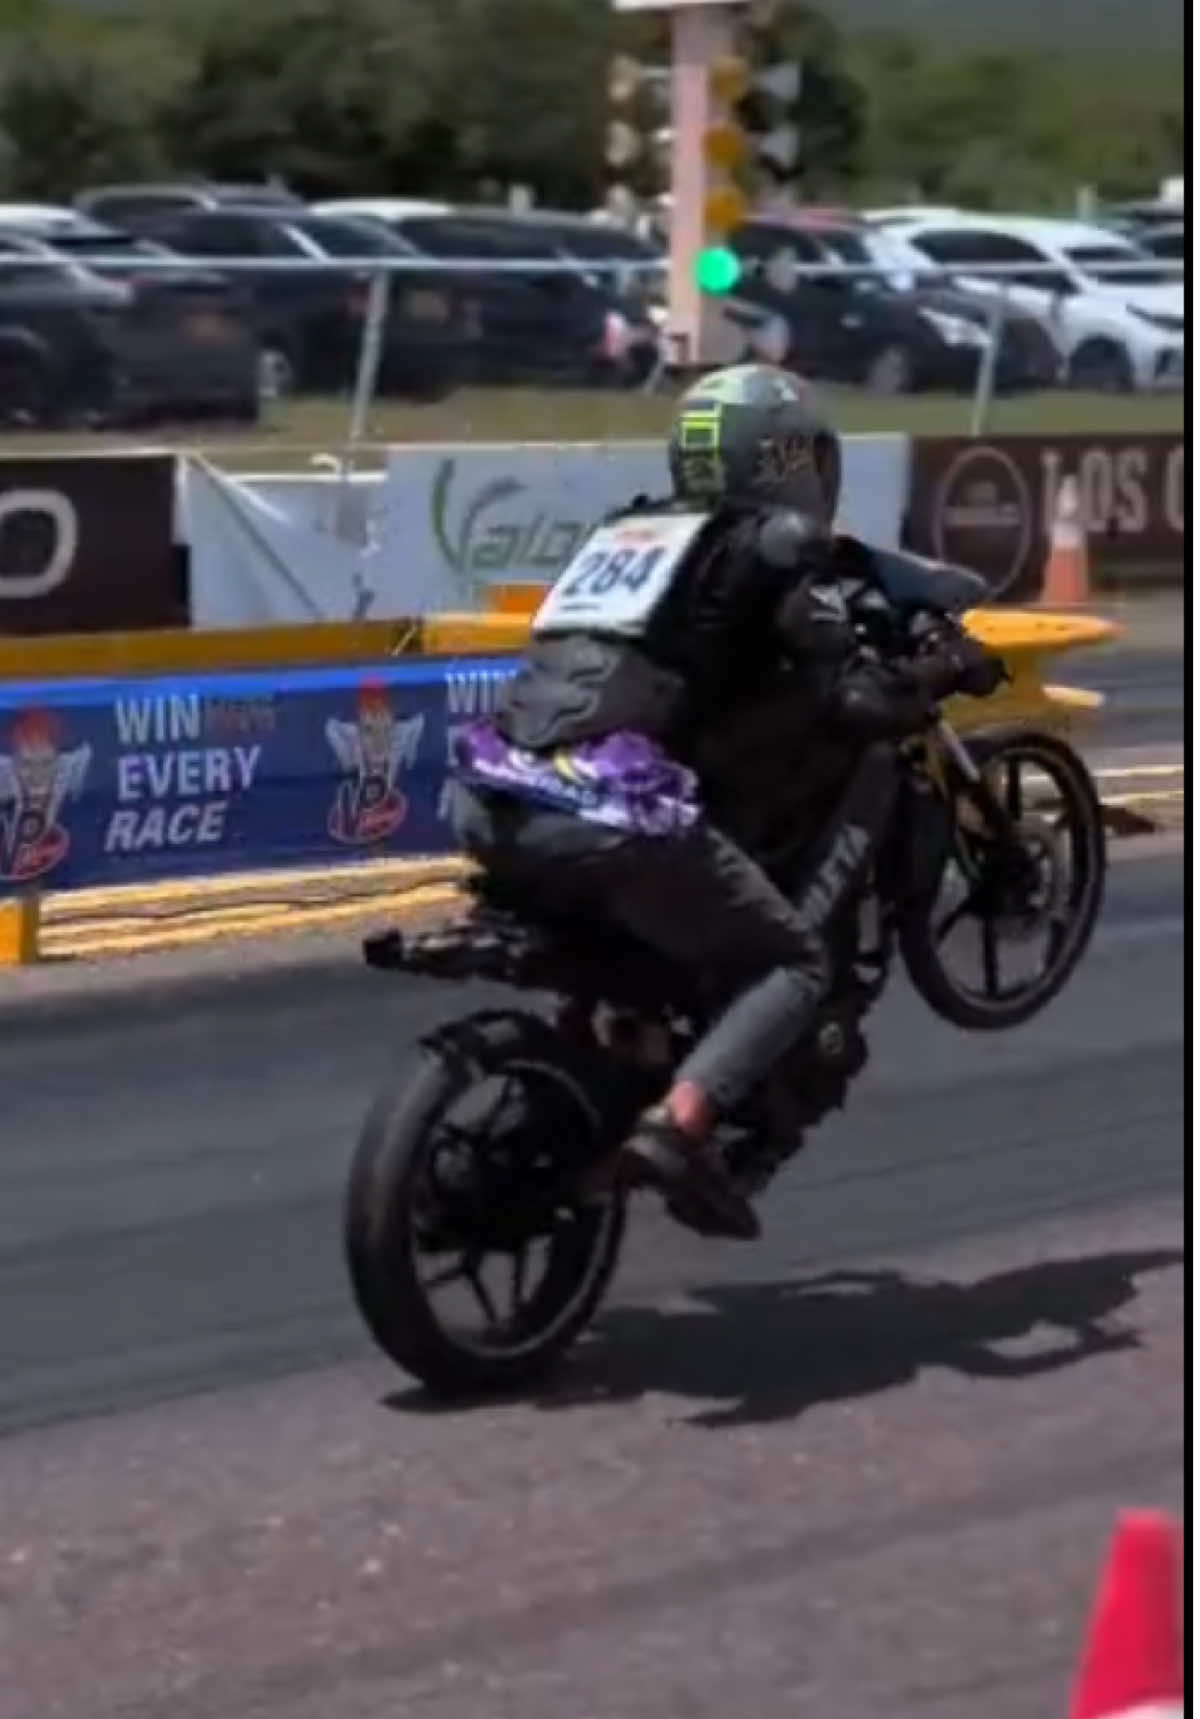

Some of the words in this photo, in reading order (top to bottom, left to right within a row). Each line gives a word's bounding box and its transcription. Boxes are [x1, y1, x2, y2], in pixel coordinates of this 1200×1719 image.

[563, 546, 665, 596] 284
[116, 693, 201, 743] WIN
[117, 745, 262, 802] EVERY
[105, 801, 229, 852] RACE
